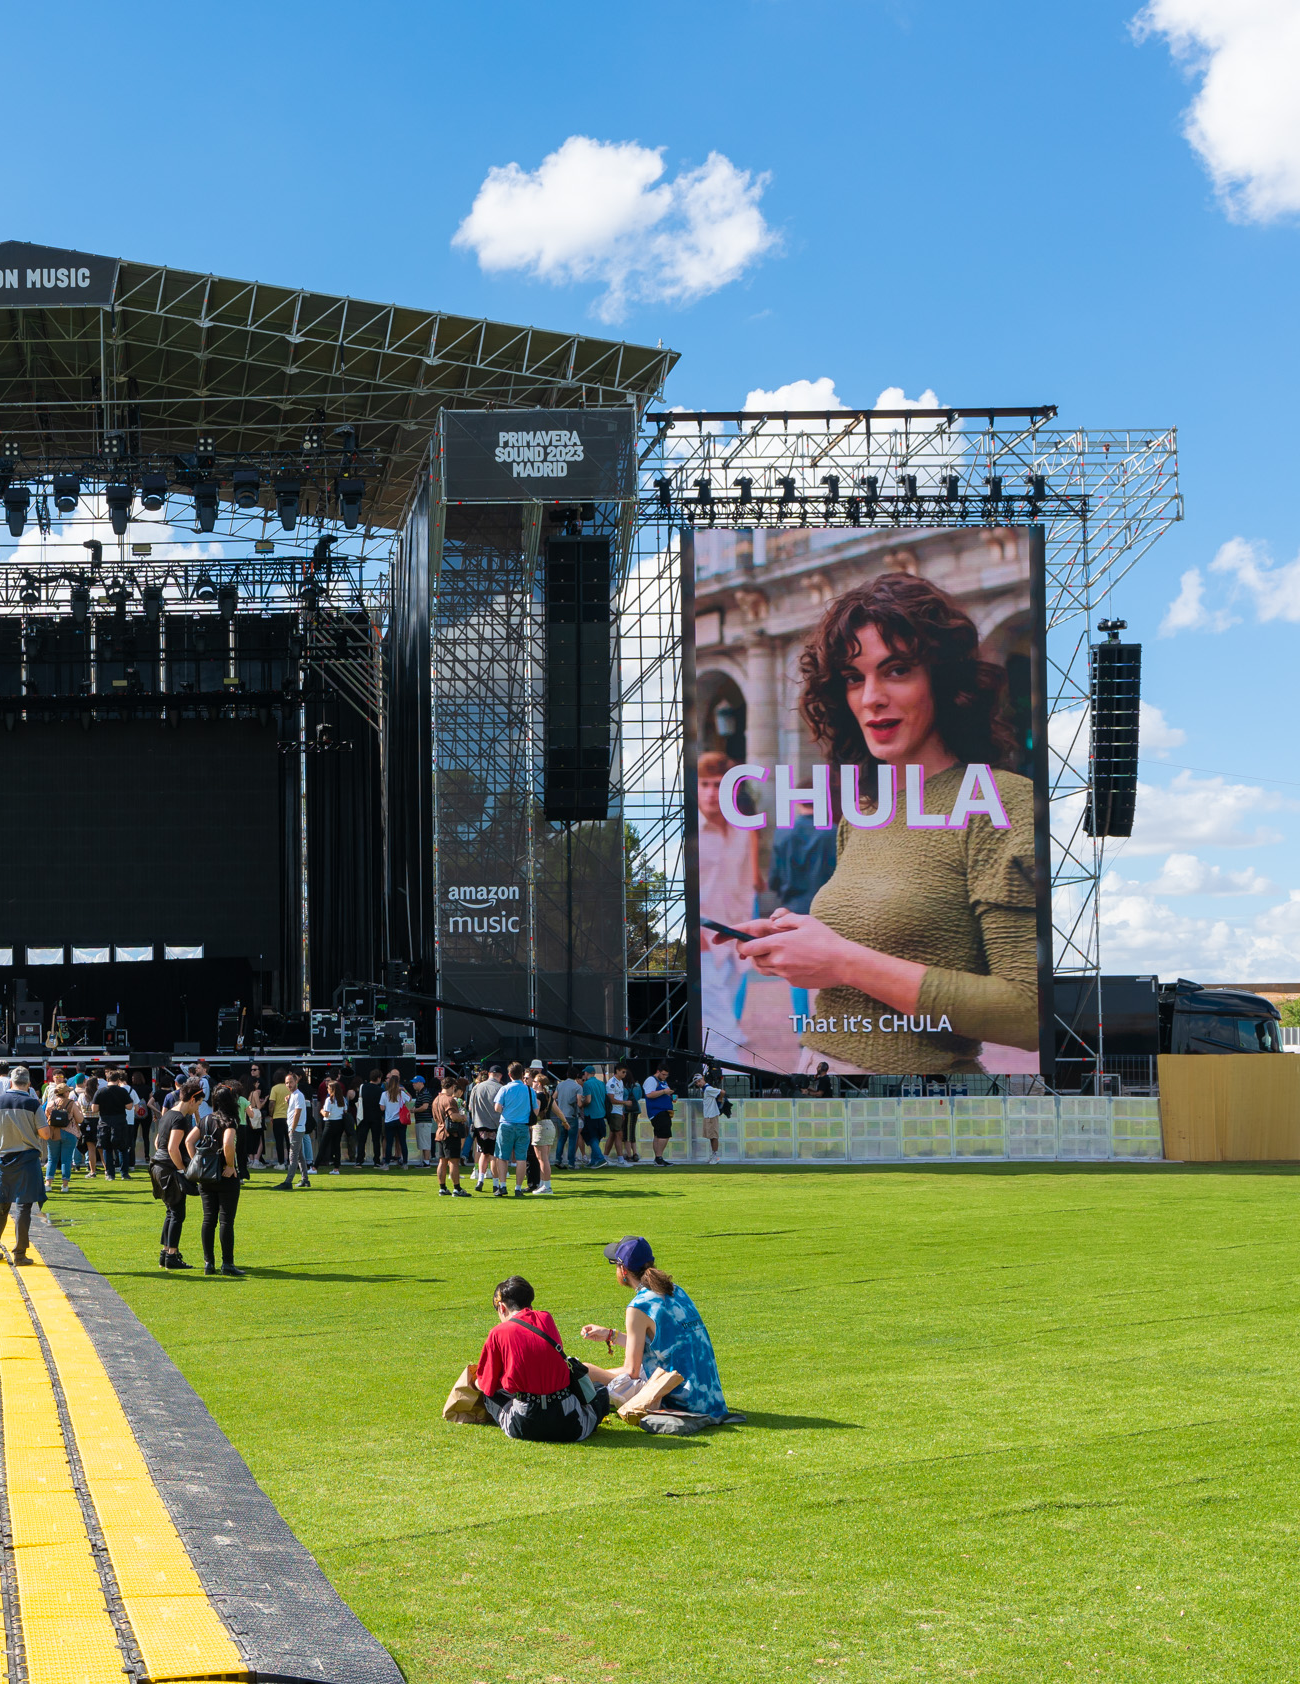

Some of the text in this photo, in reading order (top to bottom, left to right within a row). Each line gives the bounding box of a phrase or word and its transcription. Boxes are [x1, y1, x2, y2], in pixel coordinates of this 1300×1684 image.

[26, 267, 91, 289] MUSIC
[498, 430, 582, 447] PRIMAVERA
[494, 445, 584, 462] SOUND 2023
[512, 461, 568, 478] MADRID
[718, 763, 1012, 830] CHULA
[448, 886, 520, 900] amazon
[449, 910, 520, 933] music
[788, 1014, 837, 1033] That
[878, 1014, 953, 1033] CHULA
